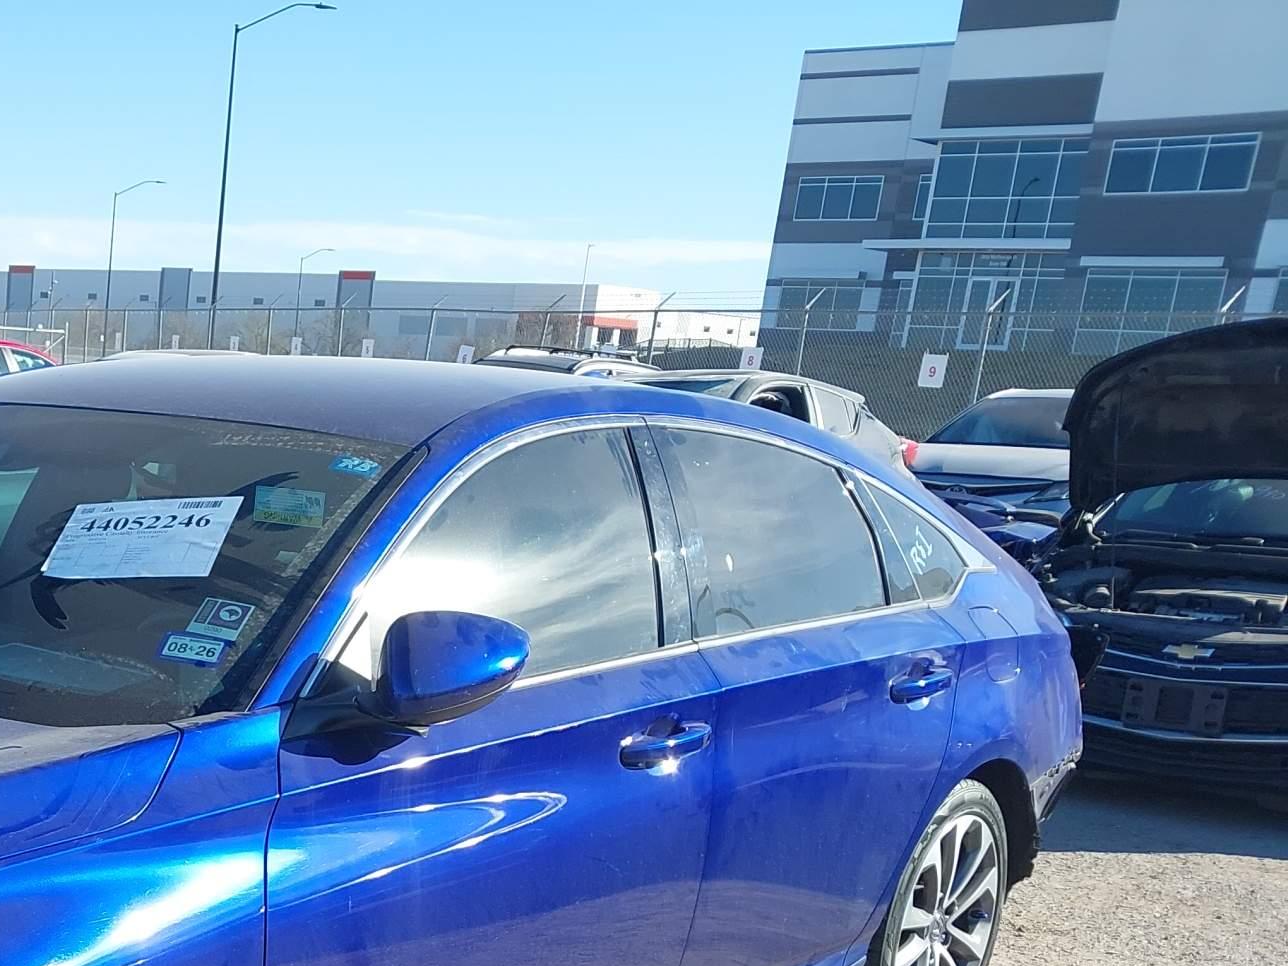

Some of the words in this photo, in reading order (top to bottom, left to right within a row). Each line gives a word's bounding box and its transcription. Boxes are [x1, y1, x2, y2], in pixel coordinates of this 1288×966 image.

[747, 355, 754, 366] 8
[928, 366, 937, 378] 9
[80, 513, 214, 533] 44052246
[167, 641, 189, 654] 08
[194, 645, 218, 658] 26
